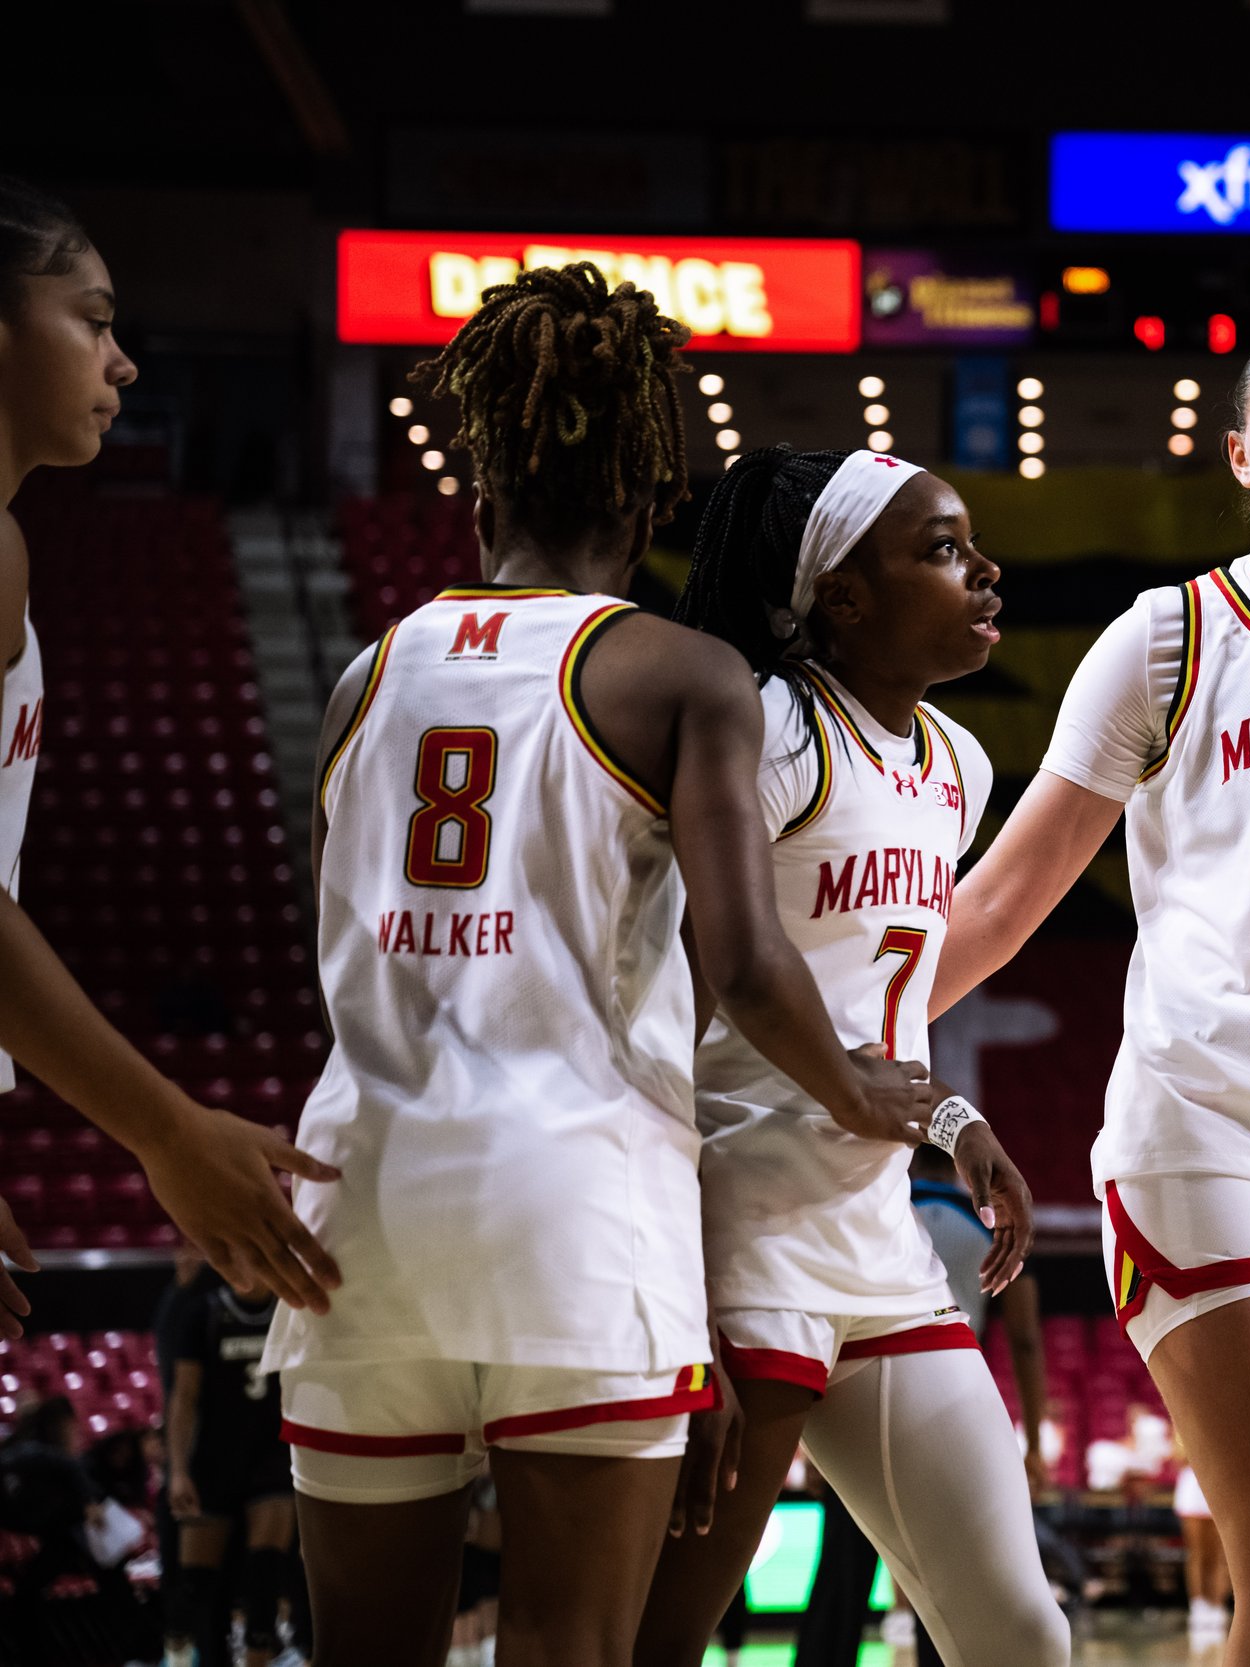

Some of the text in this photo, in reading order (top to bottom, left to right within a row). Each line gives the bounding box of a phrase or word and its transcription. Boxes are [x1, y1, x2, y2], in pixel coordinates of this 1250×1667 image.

[448, 611, 511, 654] M
[404, 725, 499, 889] 8
[378, 910, 514, 957] WALKER
[873, 926, 928, 1061] 7
